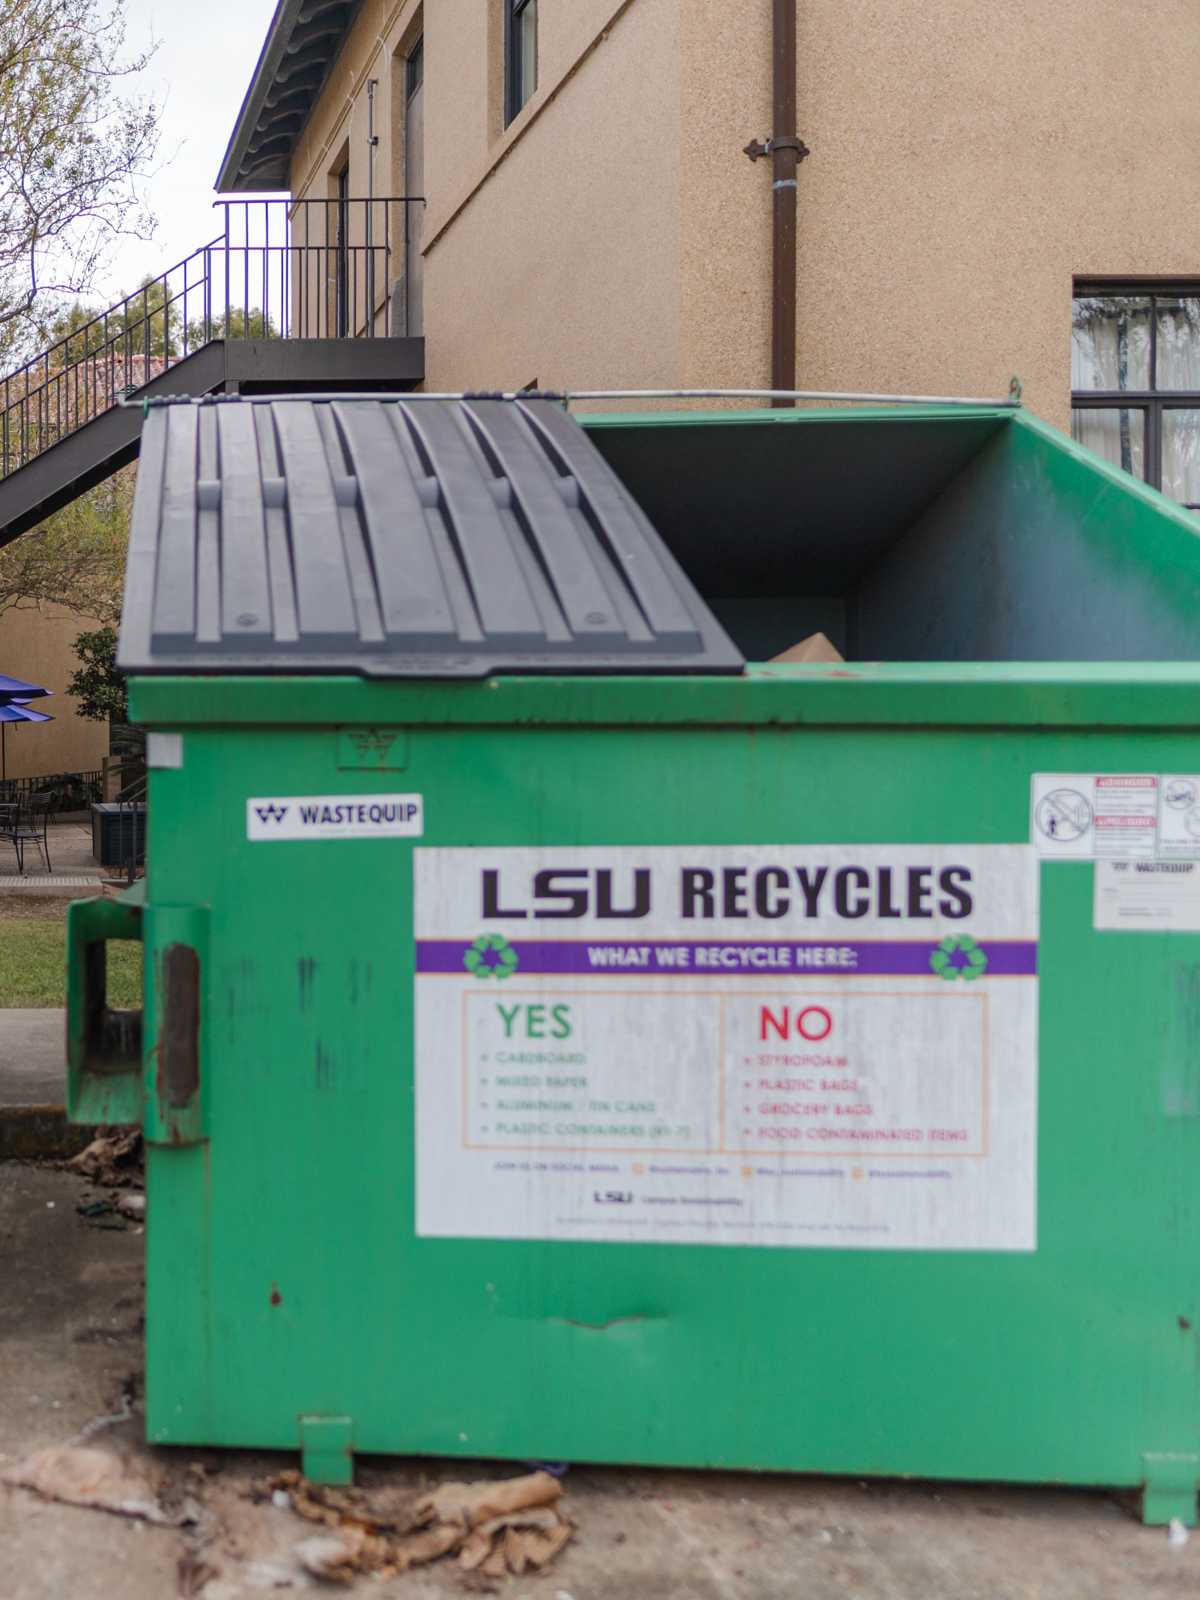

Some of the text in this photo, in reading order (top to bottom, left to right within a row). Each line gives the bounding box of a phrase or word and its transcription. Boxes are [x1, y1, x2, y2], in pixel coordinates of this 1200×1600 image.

[300, 804, 418, 824] WASTEQUIP
[482, 866, 973, 919] LSU RECYCLES
[588, 946, 858, 967] WHAT WE RECYCLE HERE:
[496, 1003, 572, 1039] YES
[760, 1005, 833, 1041] NO
